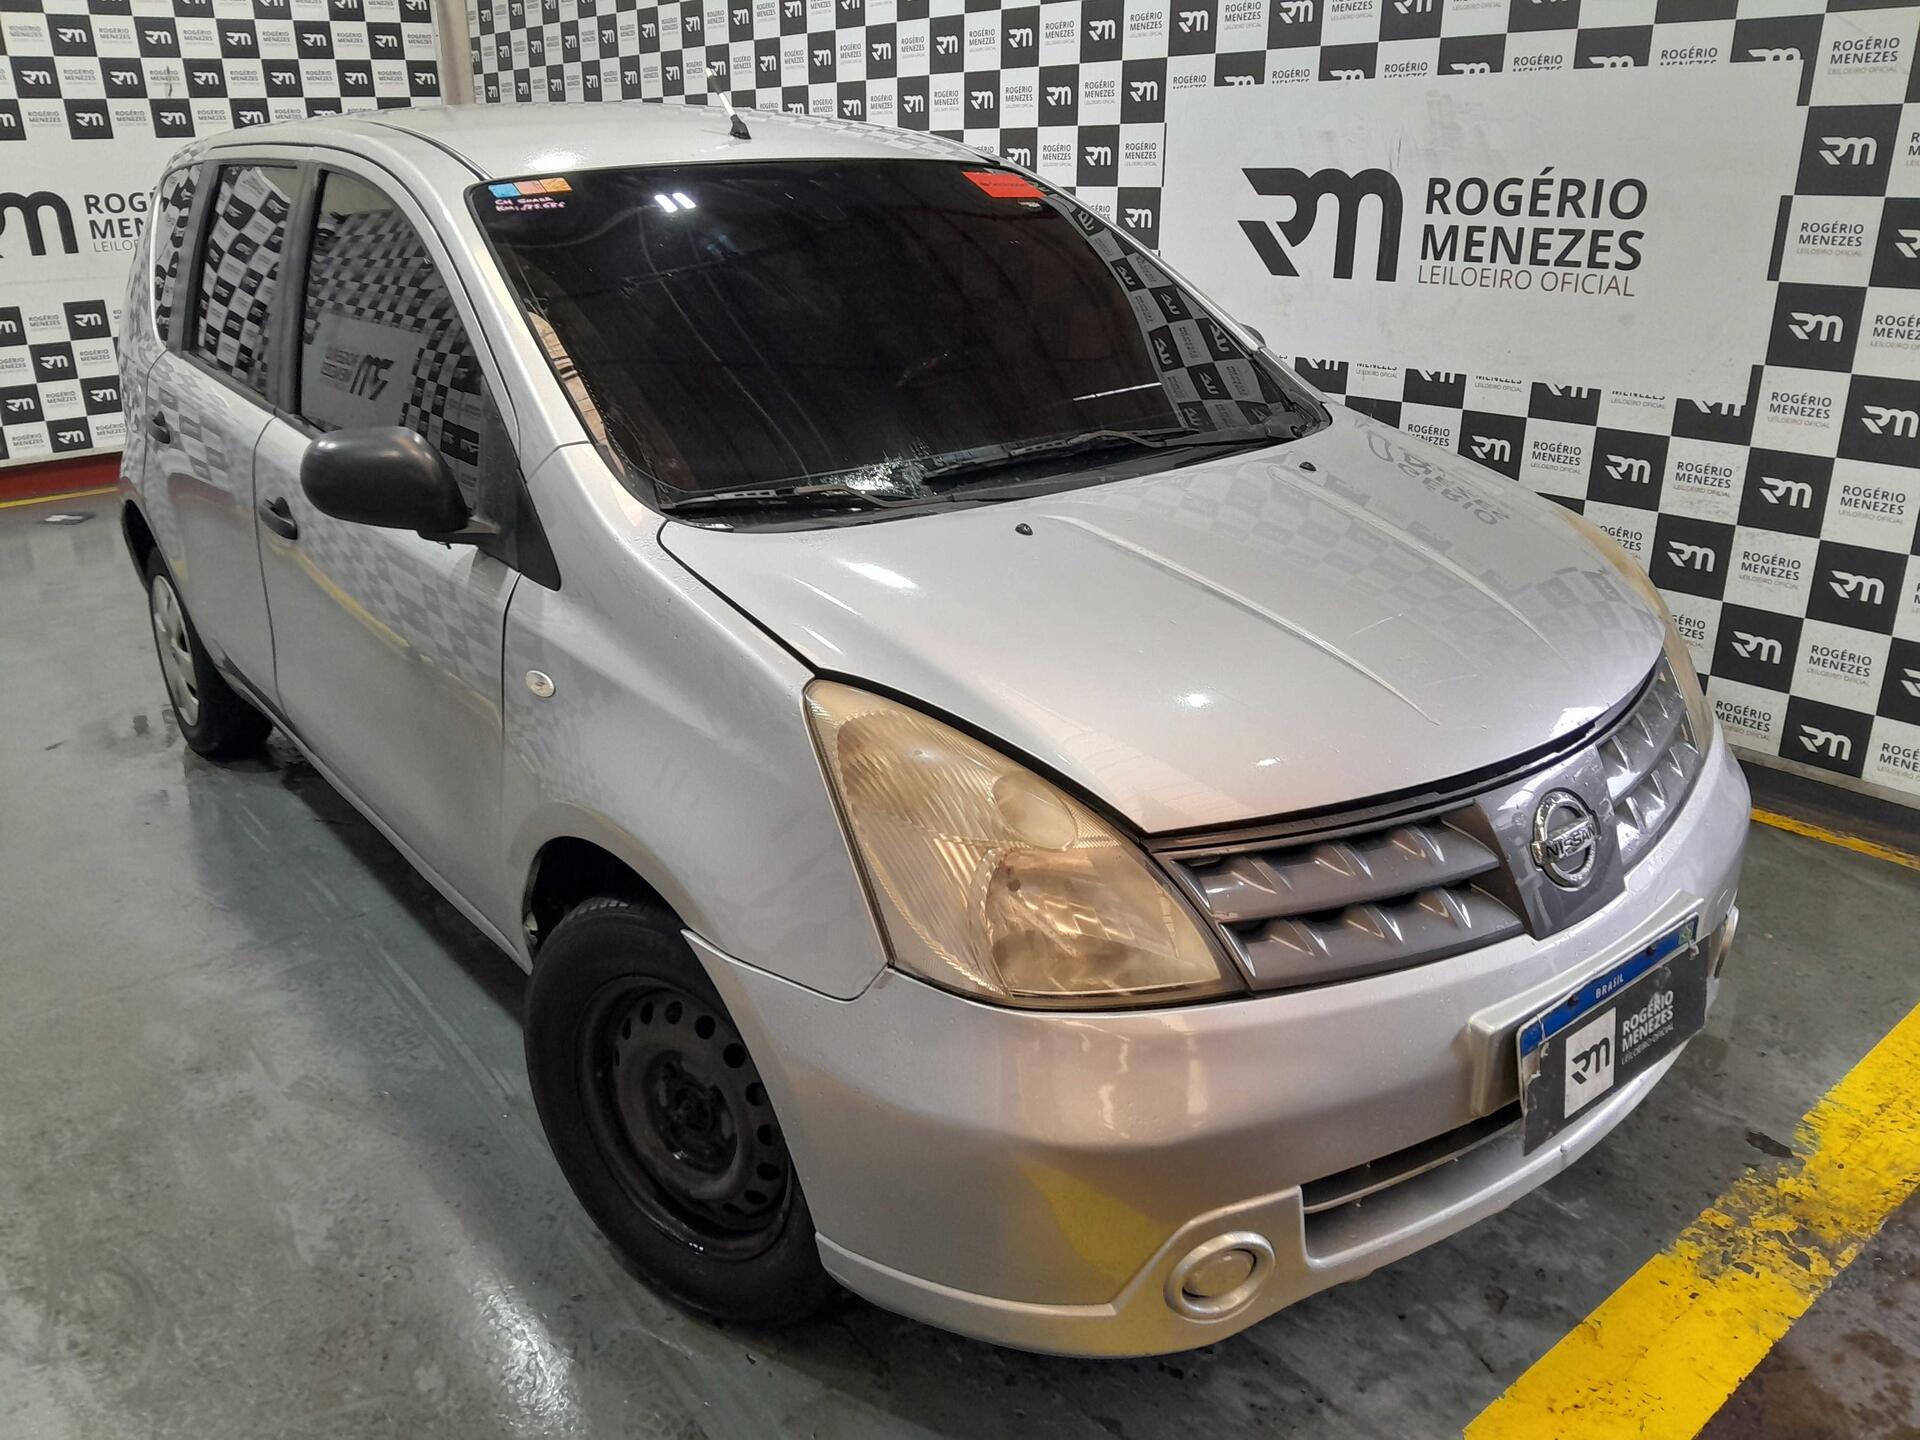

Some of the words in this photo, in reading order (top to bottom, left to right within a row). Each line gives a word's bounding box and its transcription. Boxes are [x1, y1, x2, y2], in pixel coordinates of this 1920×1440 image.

[1225, 0, 1262, 13] ROGÉRIO
[1331, 0, 1373, 13] MENEZES
[1130, 10, 1163, 22] ROGÉRIO
[1224, 11, 1261, 23] MENEZES
[1045, 19, 1075, 31] ROGÉRIO
[1129, 20, 1163, 31] MENEZES
[970, 28, 996, 38] ROGÉRIO
[1045, 29, 1075, 39] MENEZES
[970, 37, 996, 47] MENEZES
[1832, 37, 1900, 53] ROGÉRIO
[1513, 53, 1563, 66] ROGÉRIO
[1660, 45, 1719, 60] ROGÉRIO
[1829, 52, 1897, 66] MENEZES
[1272, 67, 1311, 79] ROGÉRIO
[1385, 60, 1429, 73] ROGÉRIO
[1085, 79, 1115, 90] ROGÉRIO
[1173, 73, 1207, 84] ROGÉRIO
[935, 89, 960, 99] ROGÉRIO
[1006, 84, 1033, 94] ROGÉRIO
[1084, 89, 1115, 98] MENEZES
[935, 98, 960, 107] MENEZES
[1006, 94, 1033, 103] MENEZES
[1043, 143, 1071, 152] ROGÉRIO
[1125, 141, 1157, 151] ROGÉRIO
[1124, 151, 1157, 159] MENEZES
[1425, 166, 1648, 220] ROGÉRIO
[1800, 220, 1865, 234] ROGÉRIO
[1420, 224, 1645, 271] MENEZES
[1798, 234, 1863, 247] MENEZES
[1418, 265, 1532, 290] LEILOEIRO
[1540, 271, 1635, 297] OFICIAL
[1770, 392, 1832, 407] ROGÉRIO
[1768, 403, 1830, 420] MENEZES
[1408, 423, 1451, 437] ROGÉRIO
[1533, 441, 1582, 456] ROGÉRIO
[1532, 451, 1581, 467] MENEZES
[1676, 461, 1733, 478] ROGÉRIO
[1675, 471, 1731, 489] MENEZES
[1842, 485, 1907, 503] ROGÉRIO
[1839, 496, 1905, 516] MENEZES
[1742, 551, 1801, 570] ROGÉRIO
[1740, 561, 1799, 581] MENEZES
[1810, 644, 1873, 666] ROGÉRIO
[1808, 655, 1871, 678] MENEZES
[1715, 700, 1772, 722] ROGÉRIO
[1713, 710, 1770, 733] MENEZES
[1546, 822, 1596, 856] NISSAN
[1595, 973, 1624, 999] BRASIL
[1622, 990, 1674, 1036] ROGÉRIO
[1621, 1008, 1674, 1052] MENEZES
